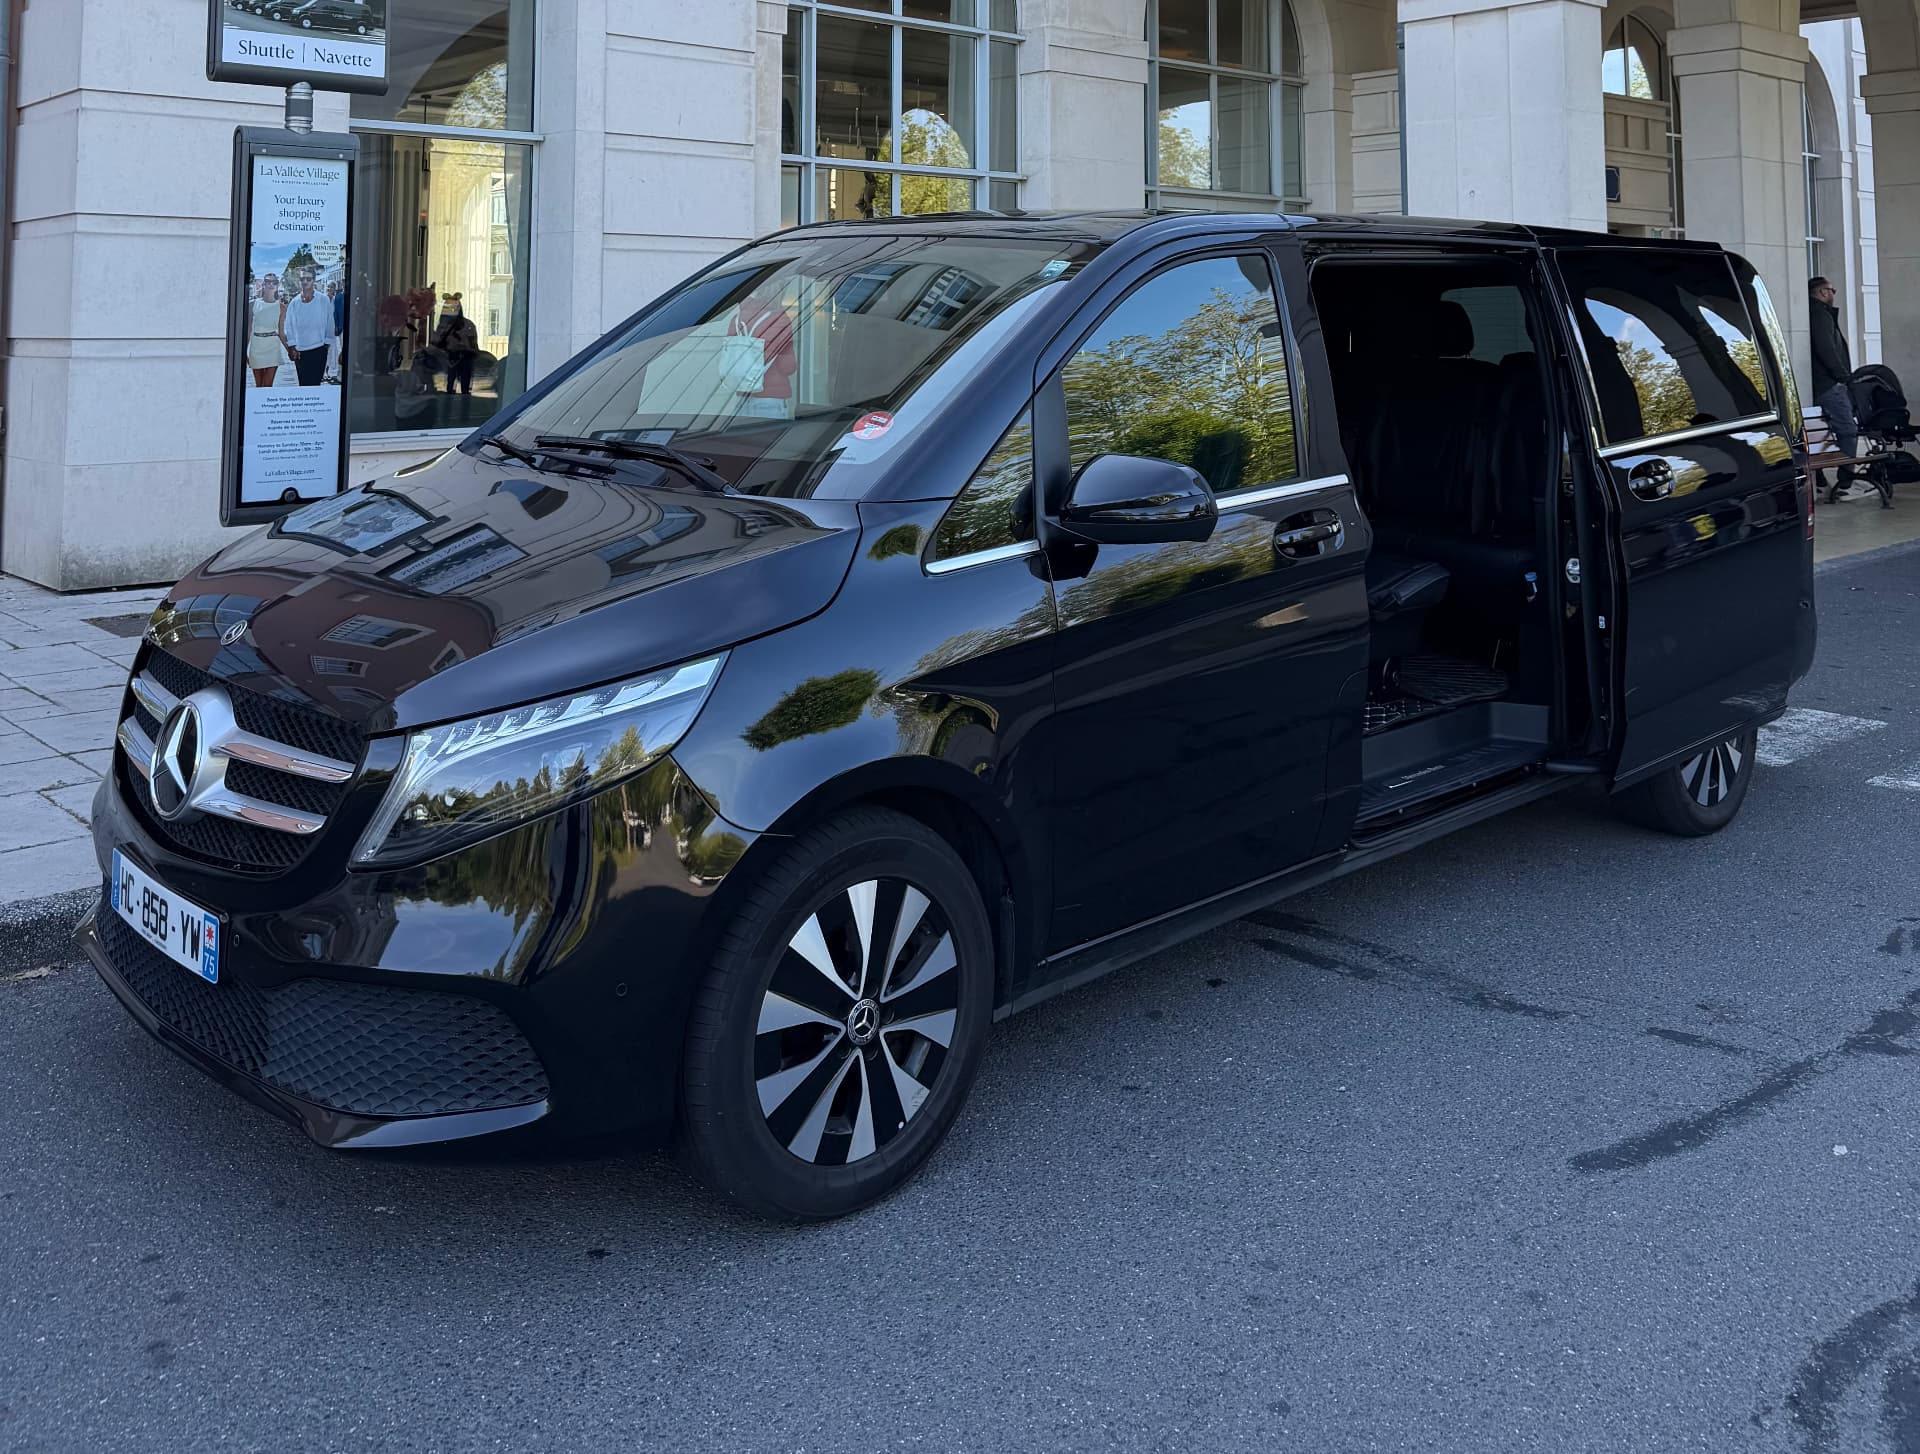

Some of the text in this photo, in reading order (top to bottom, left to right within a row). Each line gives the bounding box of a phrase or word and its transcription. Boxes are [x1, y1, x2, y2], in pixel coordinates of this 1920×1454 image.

[238, 39, 295, 60] Shuttle
[314, 47, 372, 67] Navette
[260, 165, 340, 181] La Vallée Village
[274, 195, 326, 207] Your luxury
[279, 208, 321, 221] shopping
[204, 953, 215, 975] 75
